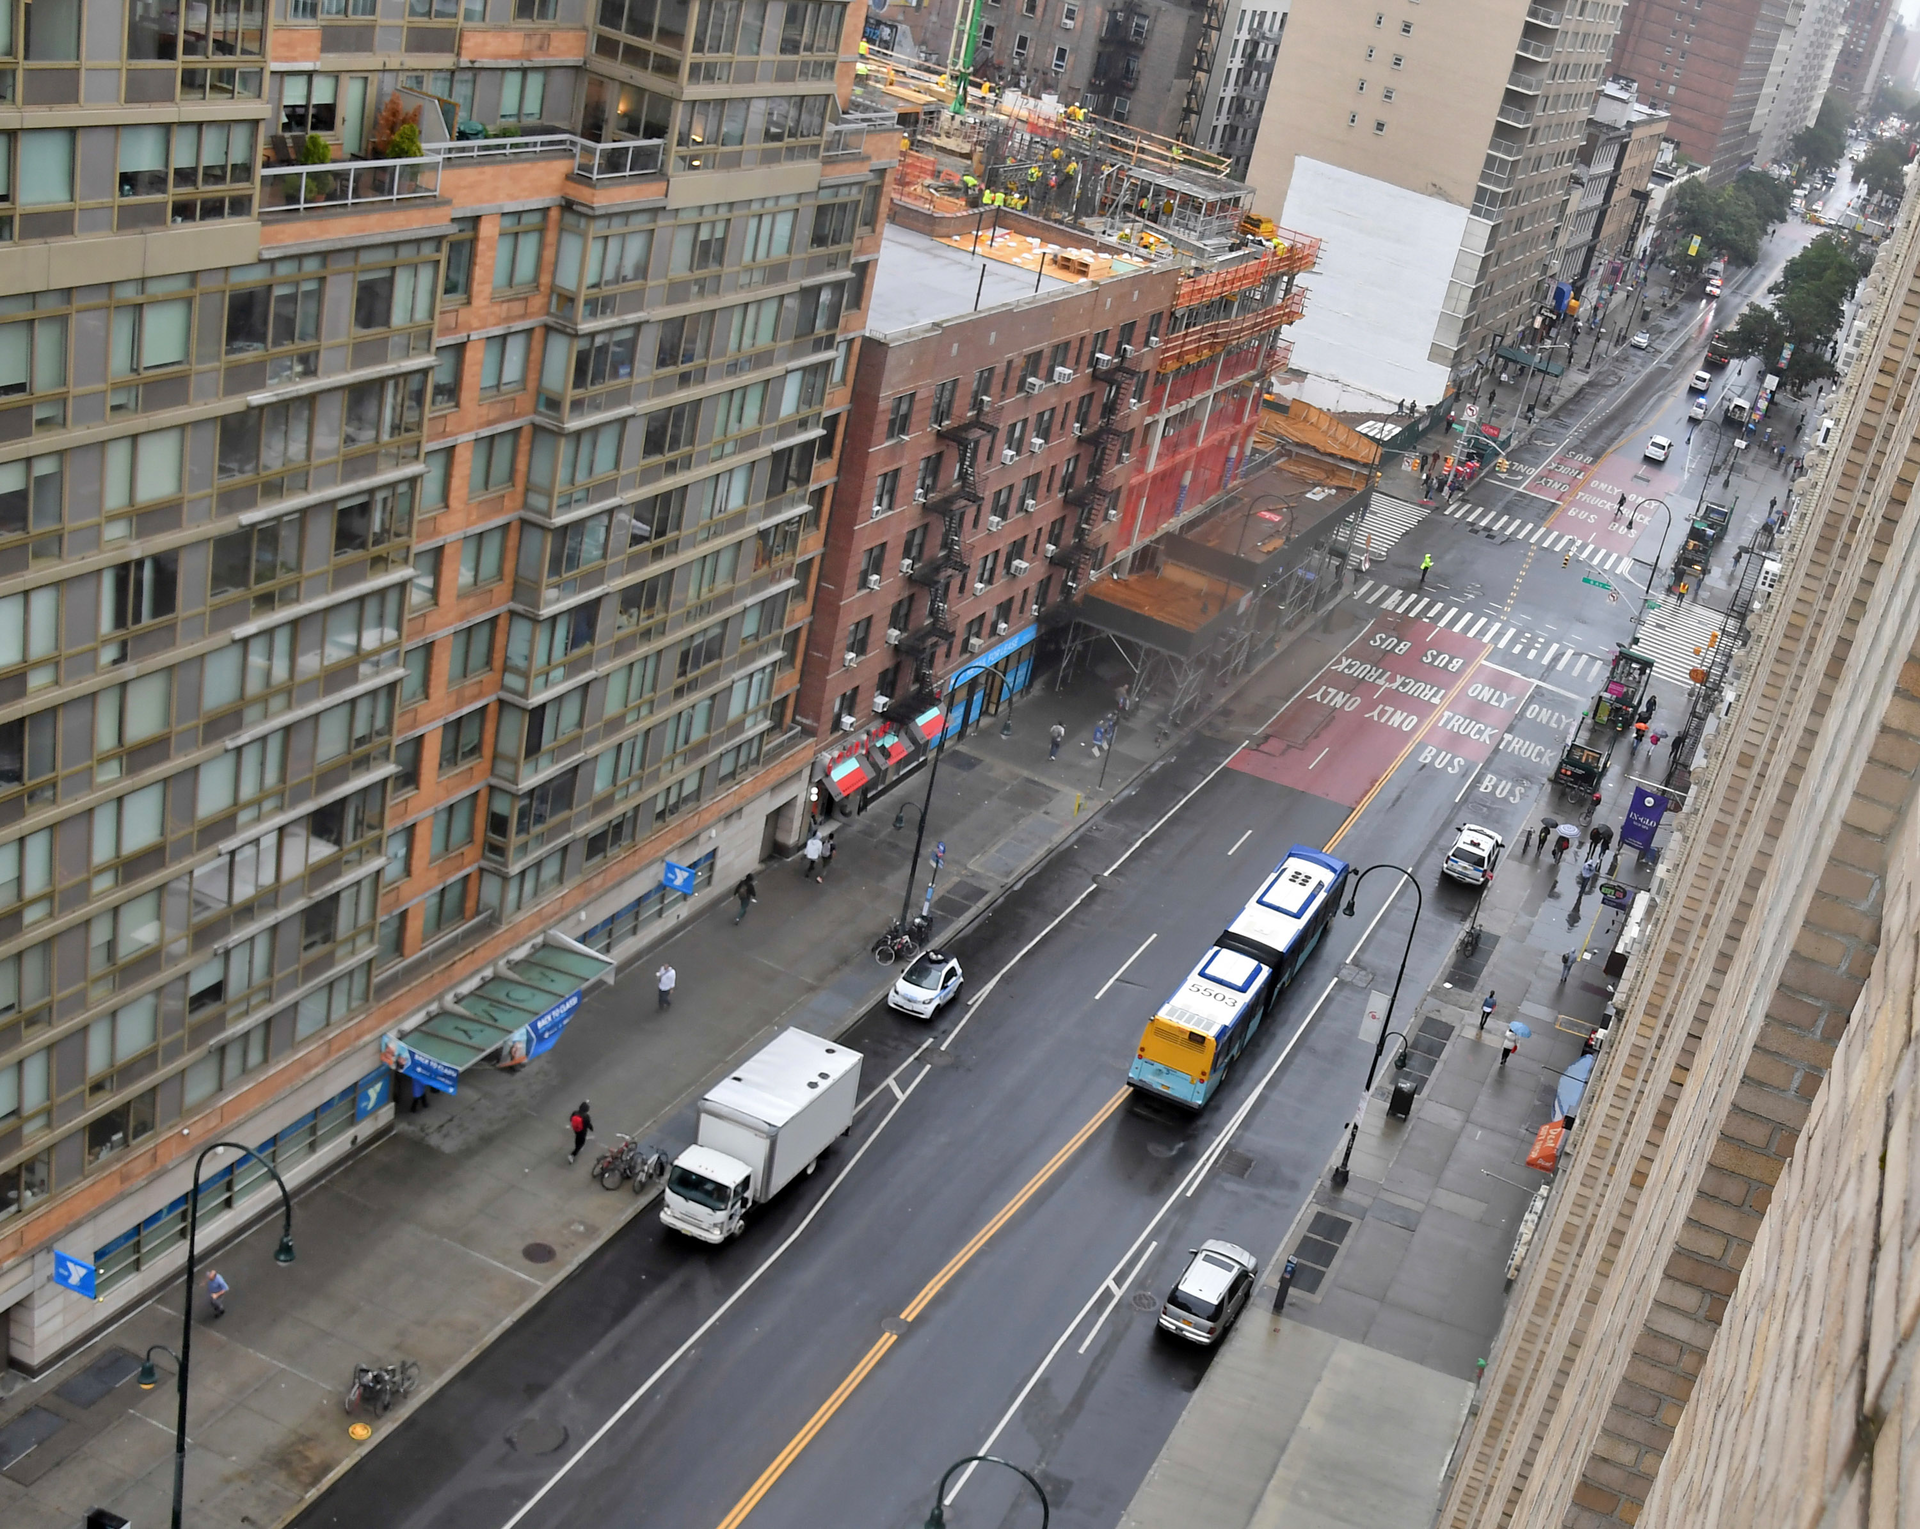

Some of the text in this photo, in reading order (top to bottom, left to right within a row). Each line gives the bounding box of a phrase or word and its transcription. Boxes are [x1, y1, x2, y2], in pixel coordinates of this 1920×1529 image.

[1566, 451, 1594, 464] BUS
[1548, 462, 1585, 480] TRUCK
[1536, 476, 1570, 492] ONLY
[1590, 480, 1622, 496] ONLY
[1575, 491, 1615, 511] TRUCK
[1568, 507, 1598, 524] BUS
[1608, 521, 1637, 538] BUS
[1369, 633, 1412, 655] BUS
[1330, 656, 1392, 685] TRUCK
[1422, 649, 1464, 672] BUS
[1307, 685, 1361, 712] ONLY
[1387, 674, 1446, 705] TRUCK
[1467, 683, 1517, 709] ONLY
[1364, 704, 1418, 731] ONLY
[1437, 711, 1499, 745] TRUCK
[1525, 704, 1574, 731] ONLY
[1418, 745, 1465, 774] BUS
[1498, 732, 1558, 766] TRUCK
[1479, 774, 1525, 804] BUS
[1188, 983, 1238, 1008] 5503
